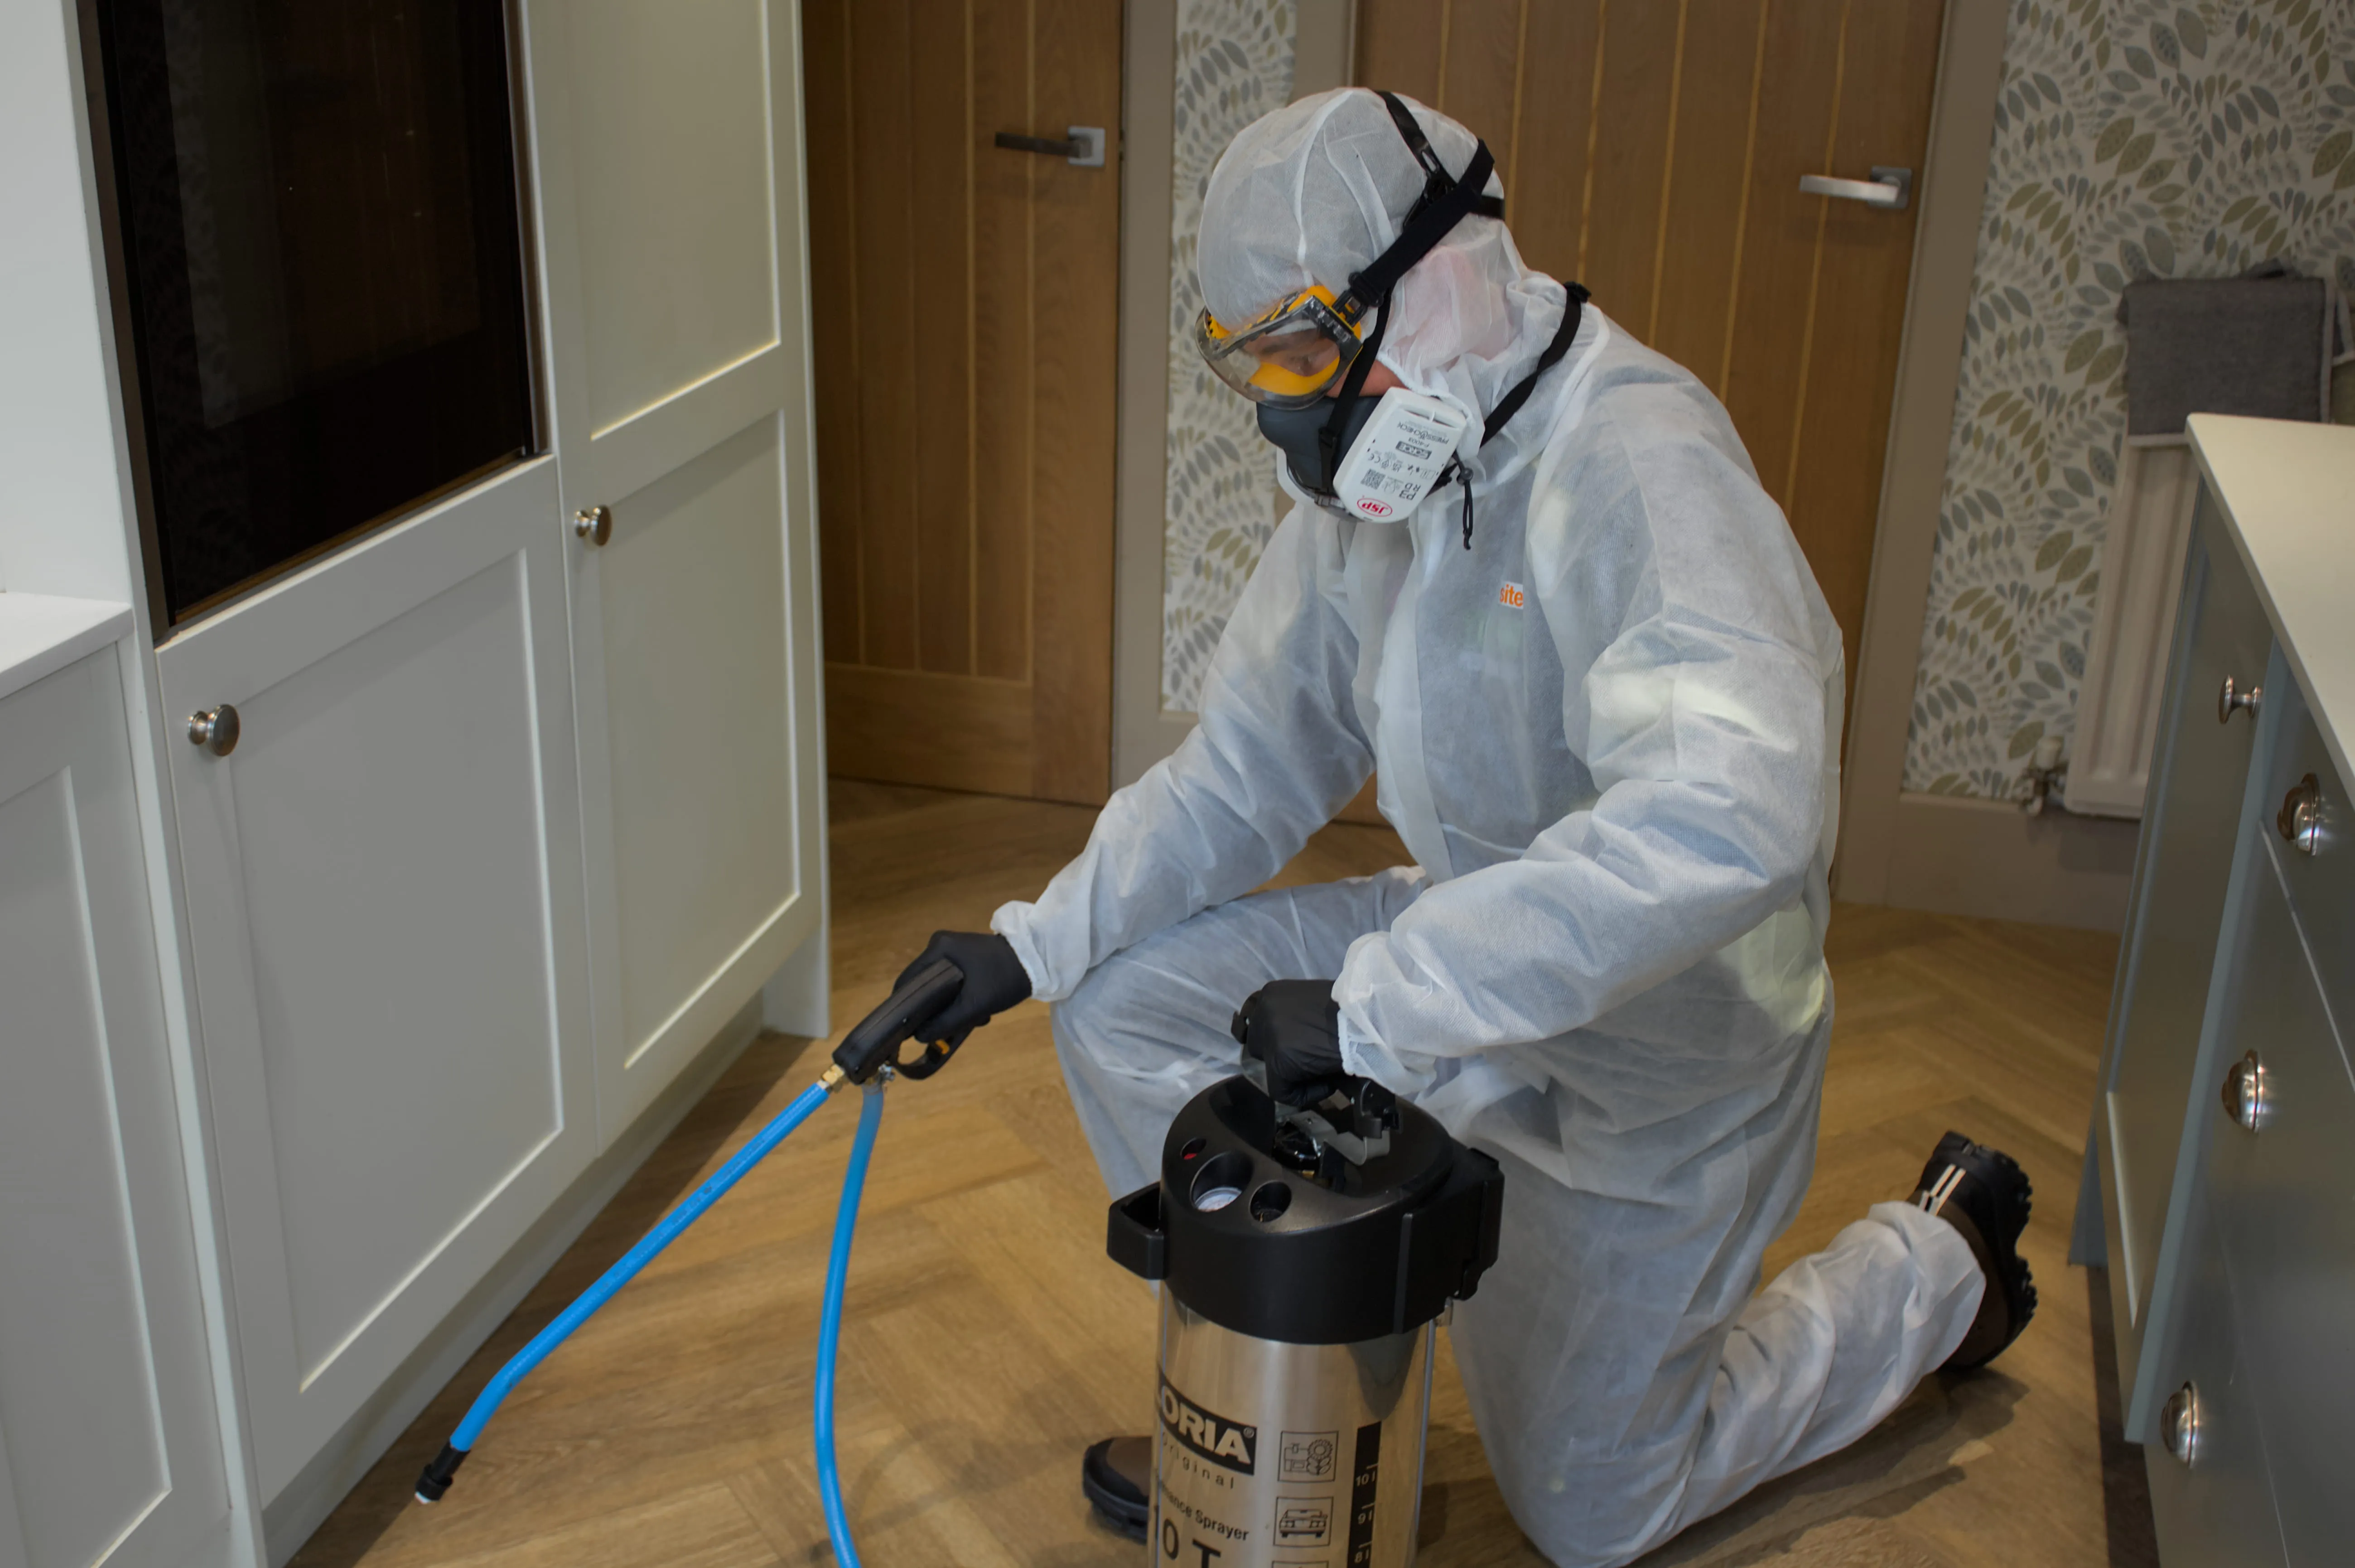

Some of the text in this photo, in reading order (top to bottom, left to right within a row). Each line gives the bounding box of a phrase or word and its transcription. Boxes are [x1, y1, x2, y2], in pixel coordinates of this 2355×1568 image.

[1399, 490, 1416, 500] P3
[1361, 502, 1389, 514] JSP
[1356, 1473, 1369, 1486] 10
[1195, 1509, 1250, 1541] Sprayer
